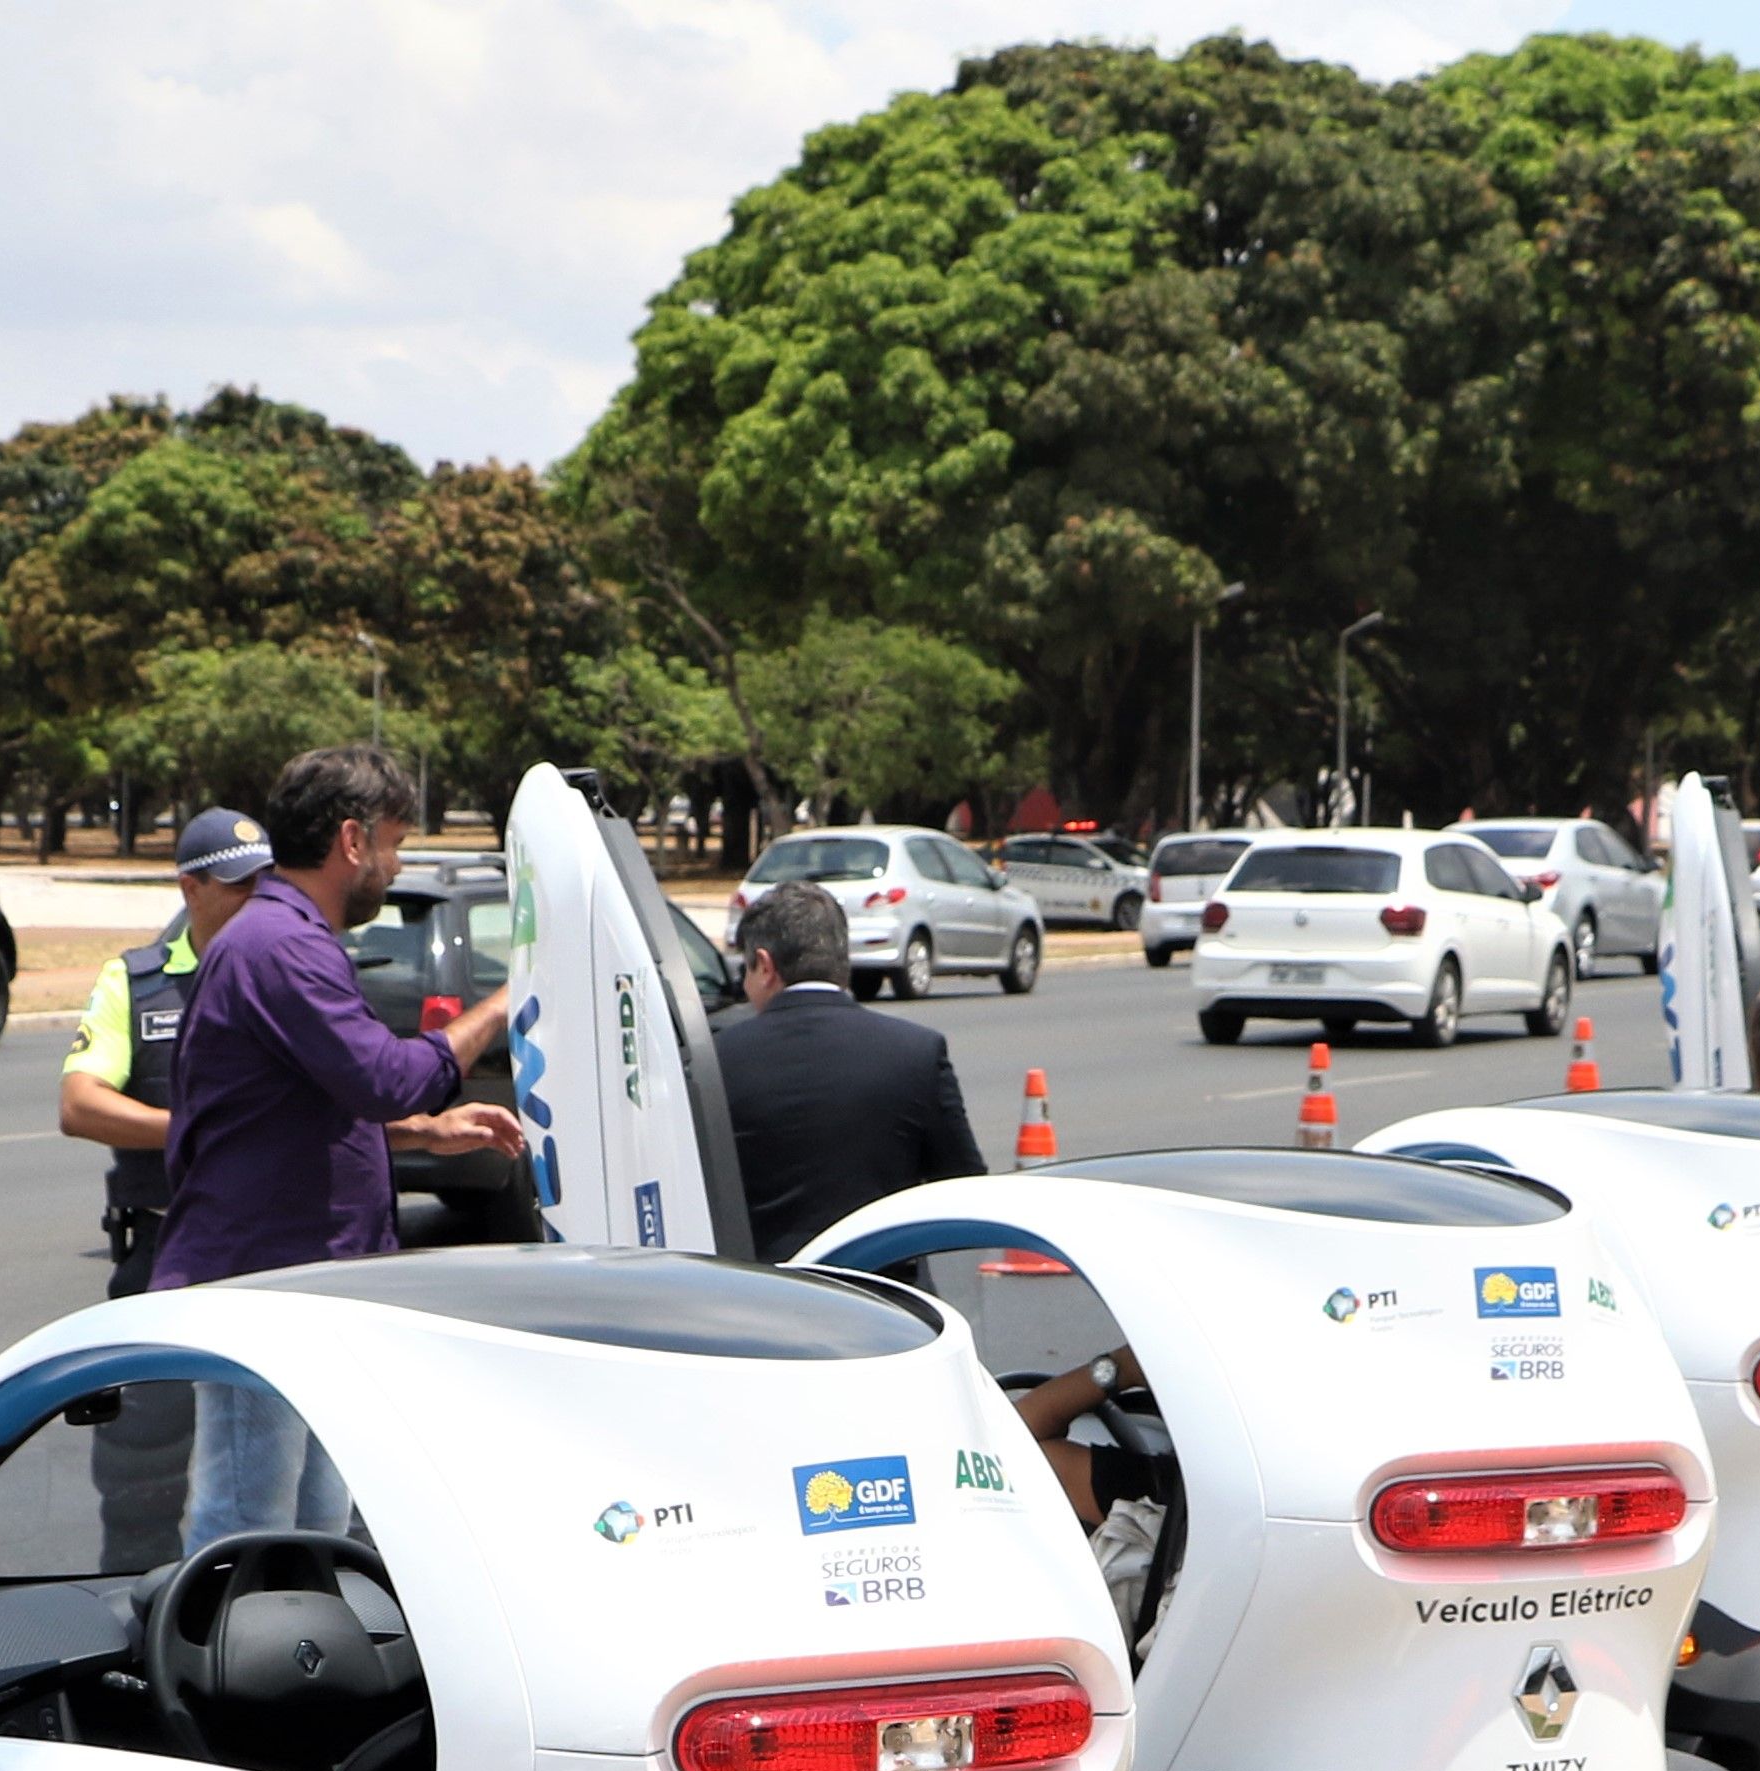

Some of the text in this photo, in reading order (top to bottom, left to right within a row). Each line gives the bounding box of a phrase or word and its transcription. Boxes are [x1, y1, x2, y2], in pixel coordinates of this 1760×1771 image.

[1368, 1290, 1397, 1309] PTI
[1519, 1282, 1555, 1300] GDF
[1491, 1343, 1564, 1358] SEGUROS
[1520, 1360, 1565, 1380] BRB
[856, 1478, 907, 1504] GDF
[654, 1503, 693, 1527] PTI
[822, 1556, 922, 1579] SEGUROS
[863, 1577, 926, 1603] BRB
[1417, 1585, 1654, 1624] Veículo Elétrico
